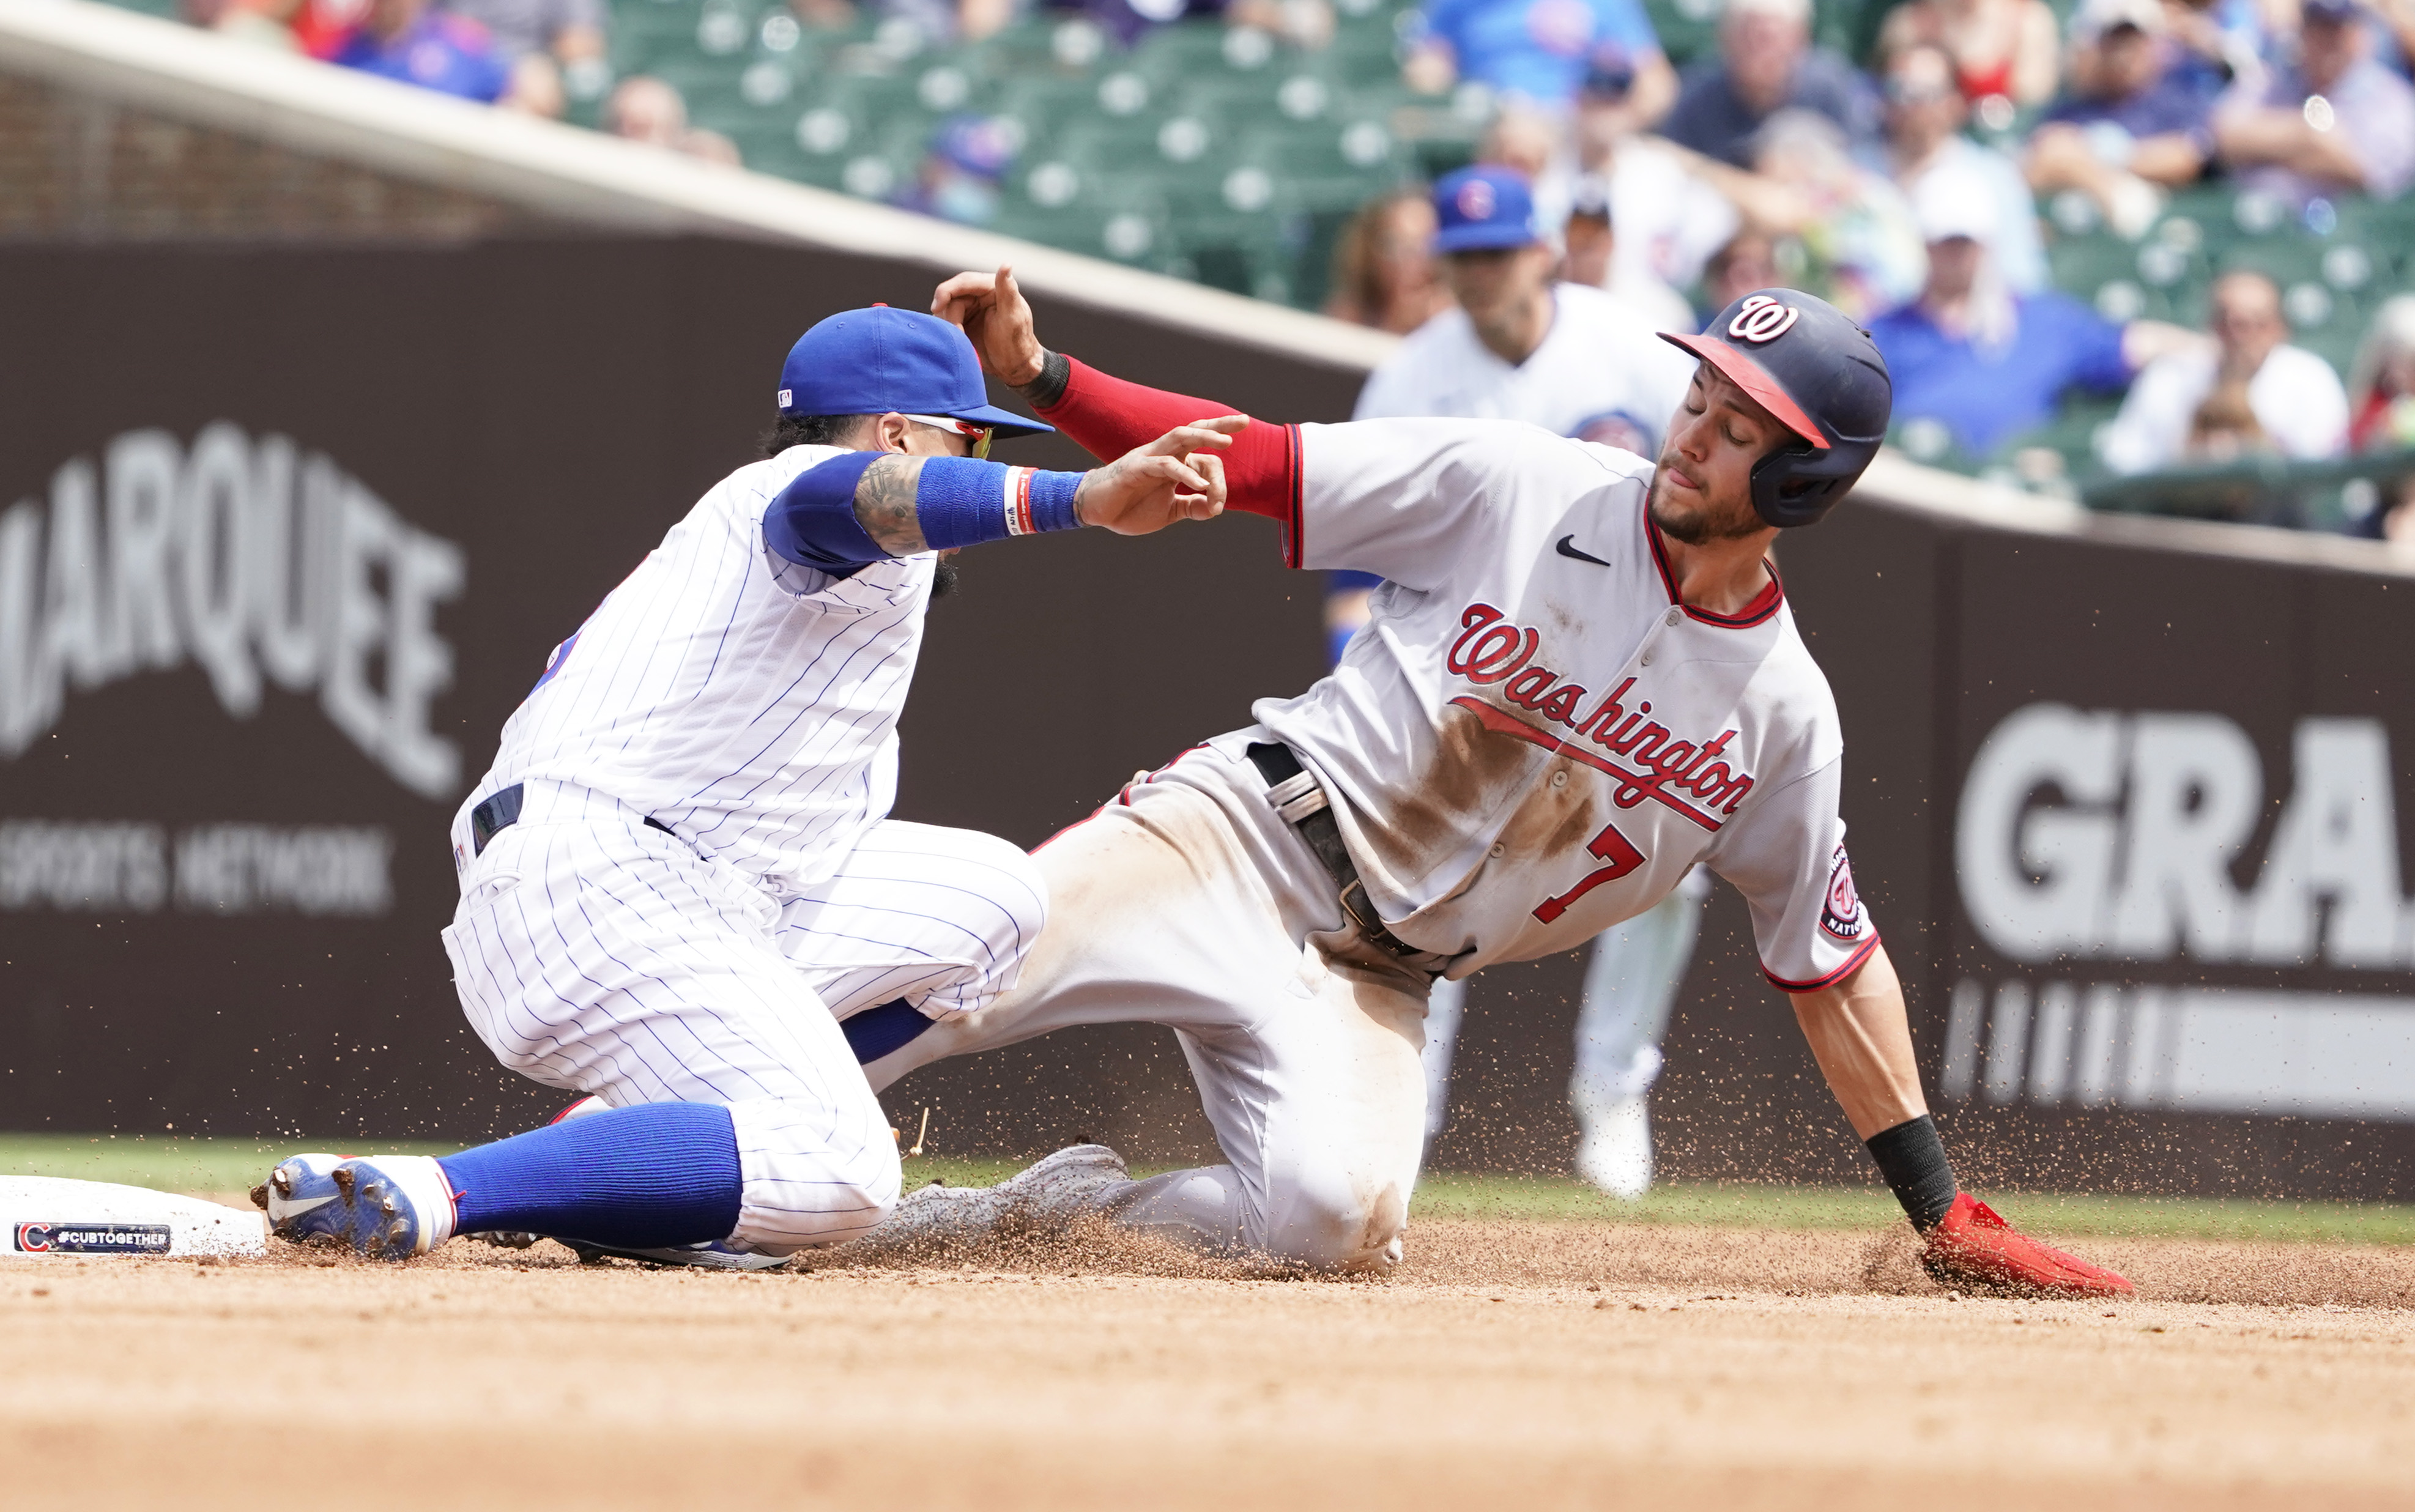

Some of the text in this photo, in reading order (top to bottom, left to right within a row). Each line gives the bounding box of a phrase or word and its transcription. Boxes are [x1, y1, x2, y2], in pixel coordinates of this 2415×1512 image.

[1729, 296, 1798, 343] W
[1447, 602, 1754, 826] Washington
[176, 823, 393, 915] NETWORK
[1531, 822, 1647, 925] 7
[1955, 702, 2415, 969] GRA
[18, 1222, 52, 1253] C
[58, 1231, 166, 1245] #CUBTOGETHER
